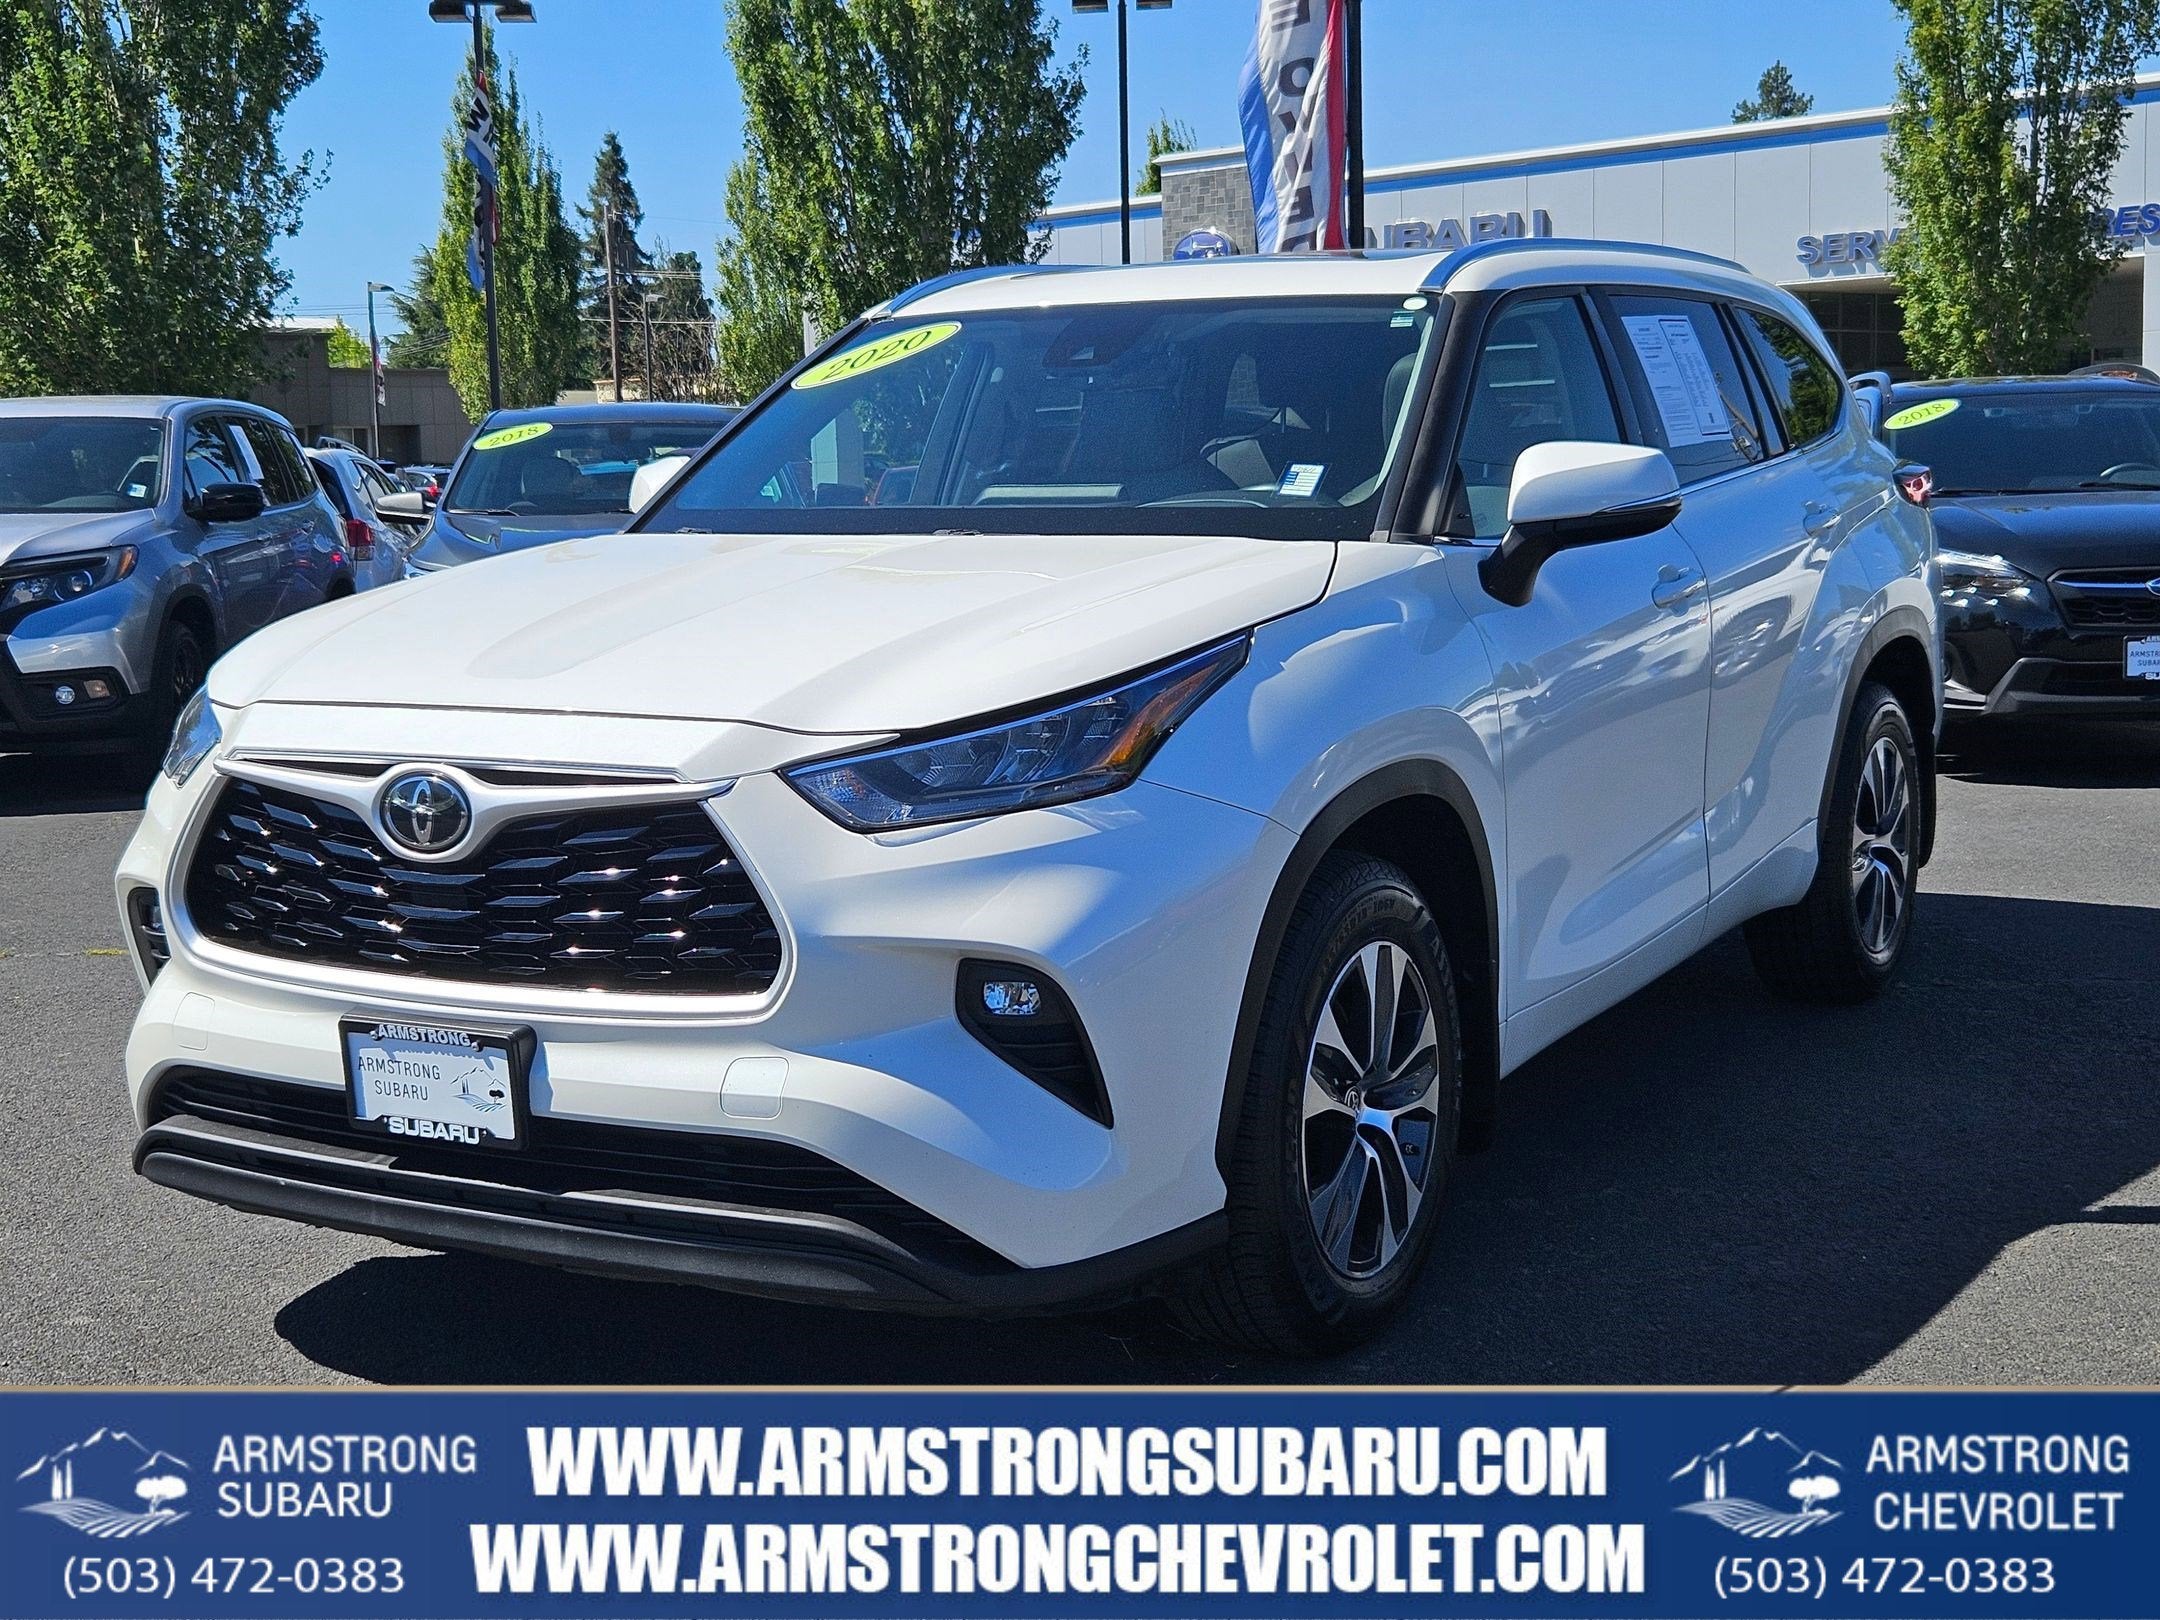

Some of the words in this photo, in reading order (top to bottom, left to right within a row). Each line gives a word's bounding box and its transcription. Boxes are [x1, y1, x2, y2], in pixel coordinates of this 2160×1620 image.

[1364, 209, 1553, 249] UBARU
[1796, 228, 1907, 264] SERV
[820, 331, 932, 381] 2020
[1899, 403, 1945, 425] 2018
[489, 426, 539, 447] 2018
[378, 1024, 472, 1047] ARMSTRONG
[357, 1056, 441, 1080] ARMSTRONG
[374, 1079, 429, 1101] SUBARU
[389, 1116, 480, 1145] SUBARU
